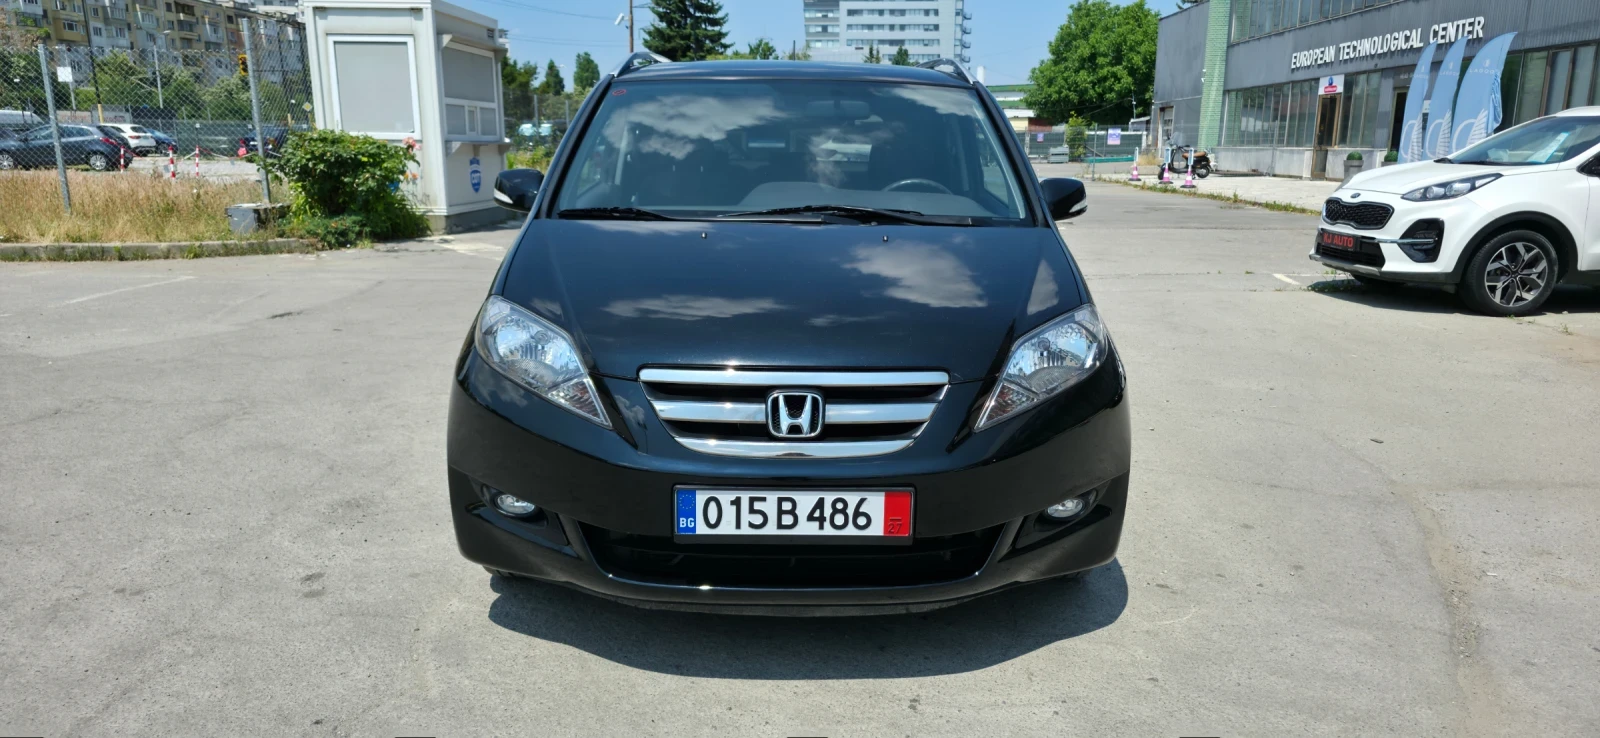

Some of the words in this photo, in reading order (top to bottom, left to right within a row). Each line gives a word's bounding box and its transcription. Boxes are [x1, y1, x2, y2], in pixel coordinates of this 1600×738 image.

[1290, 45, 1336, 69] EUROPEAN
[1339, 27, 1424, 61] TECHNOLOGICAL
[1429, 16, 1485, 44] CENTER
[1334, 235, 1353, 247] AUTO
[679, 517, 695, 528] BG
